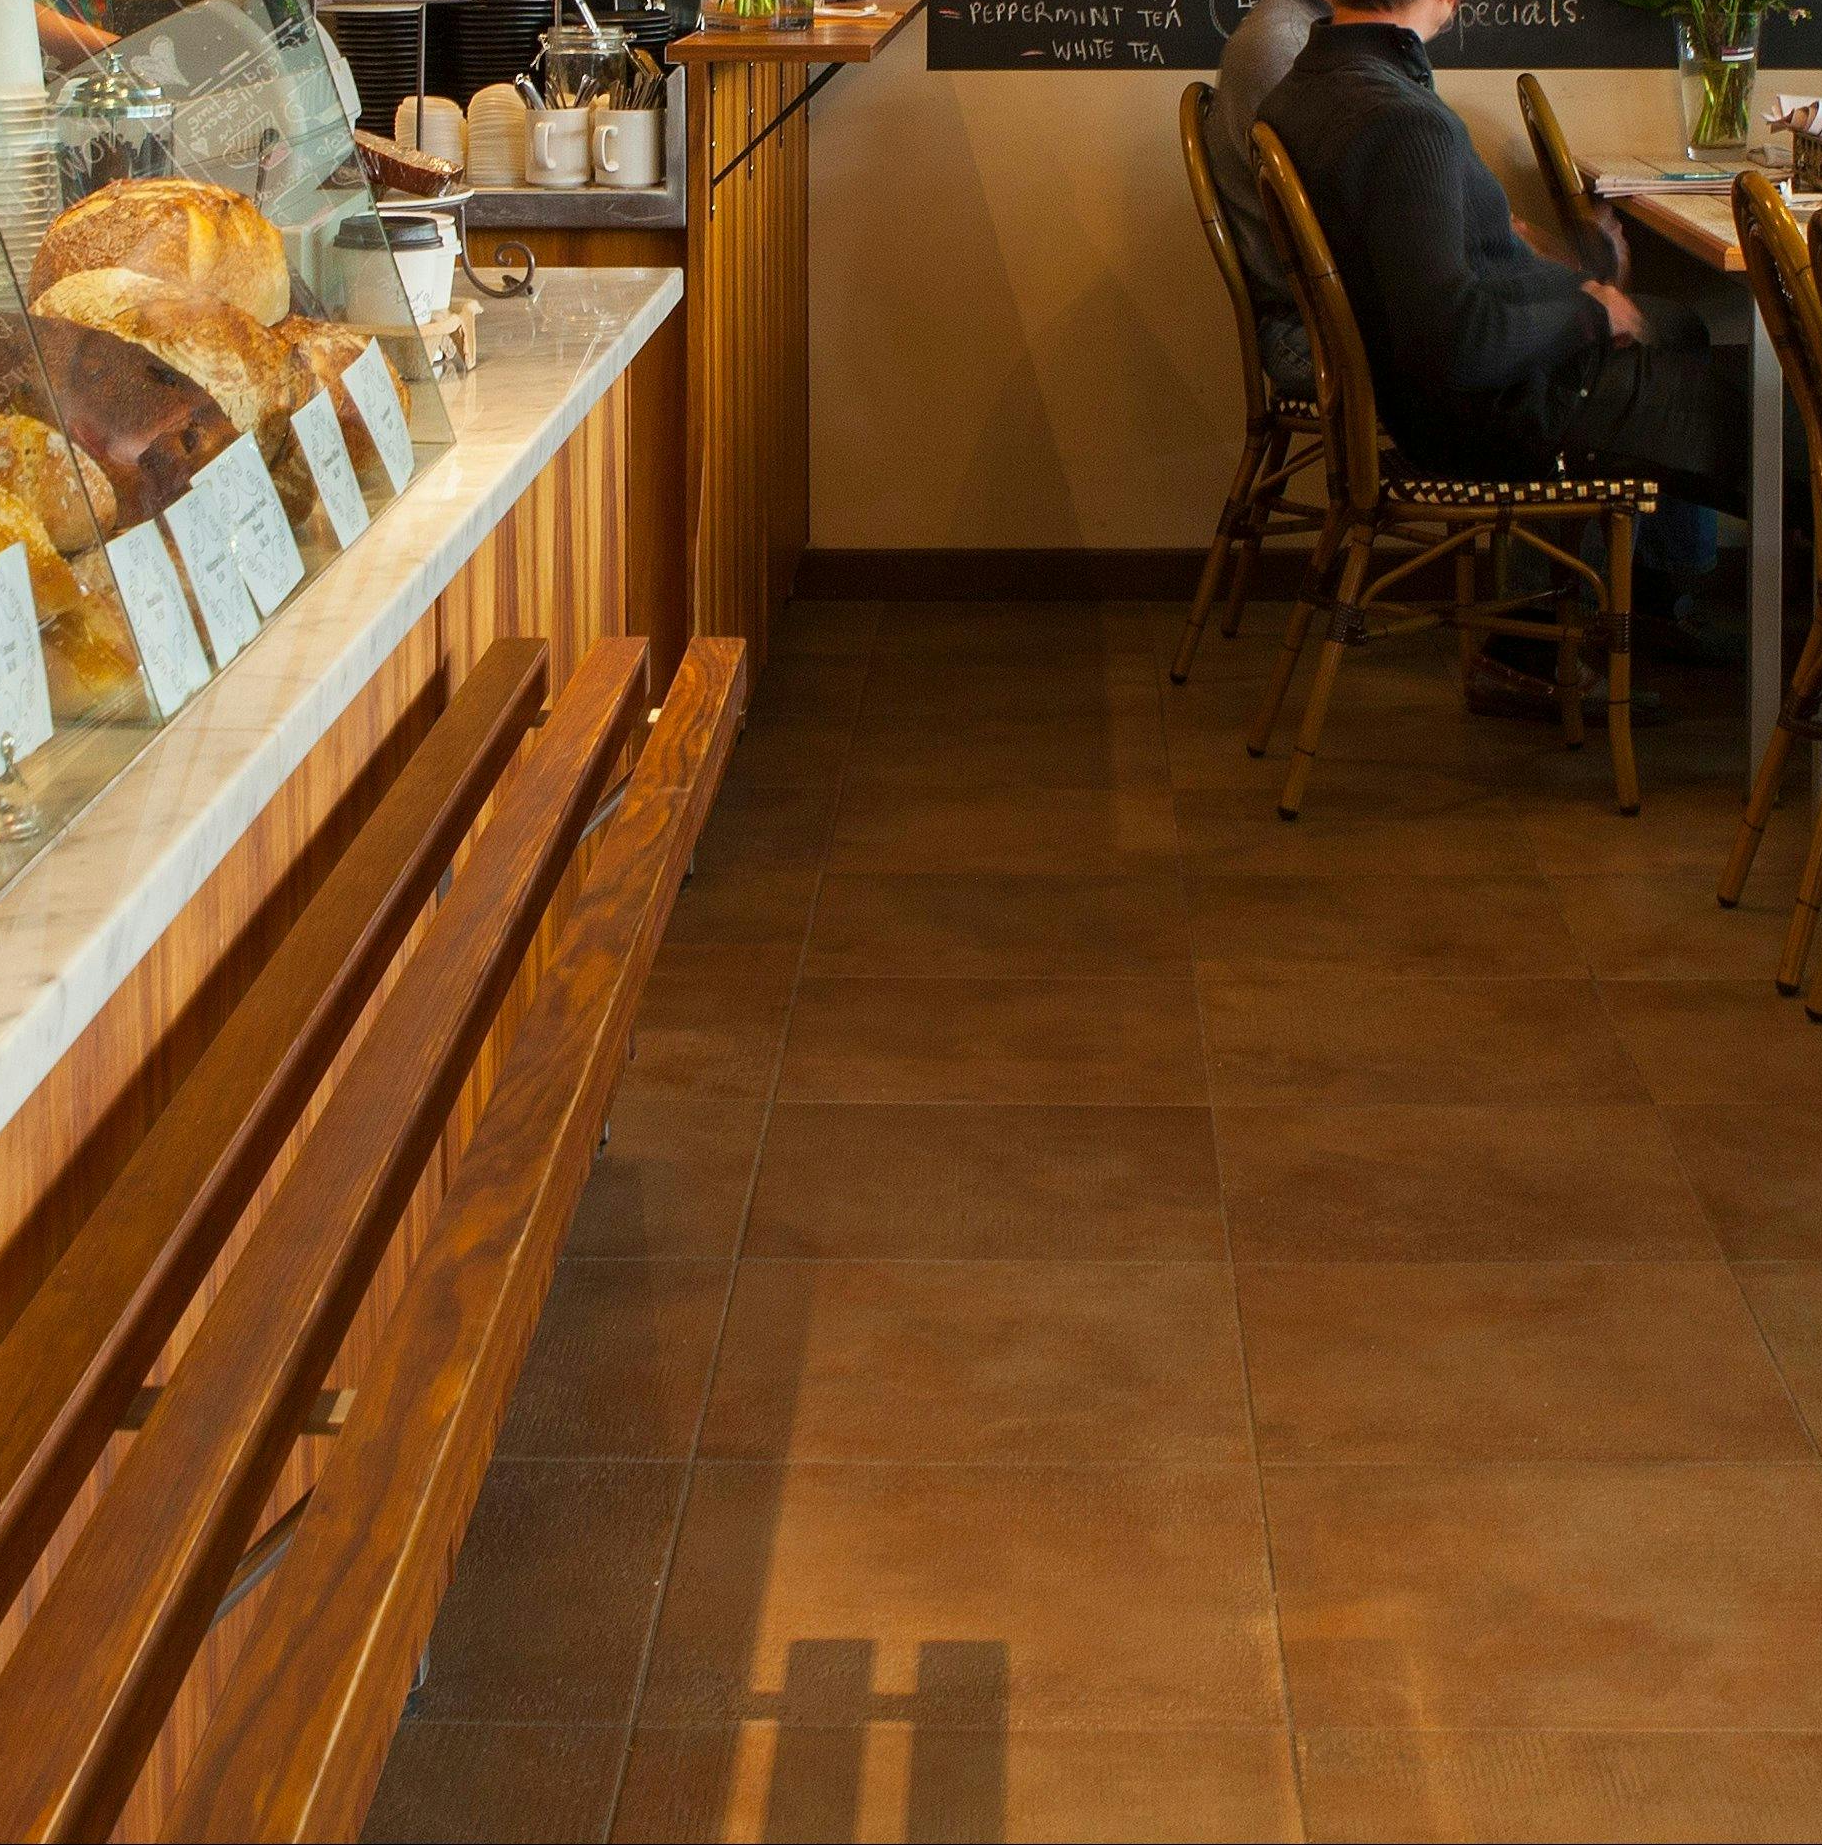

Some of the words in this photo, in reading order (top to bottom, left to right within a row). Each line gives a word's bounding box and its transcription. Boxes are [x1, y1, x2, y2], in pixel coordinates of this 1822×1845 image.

[969, 1, 1124, 27] PEPPERMINT
[1137, 7, 1182, 29] TEA
[1051, 38, 1114, 62] WHITE
[1127, 40, 1166, 64] TEA
